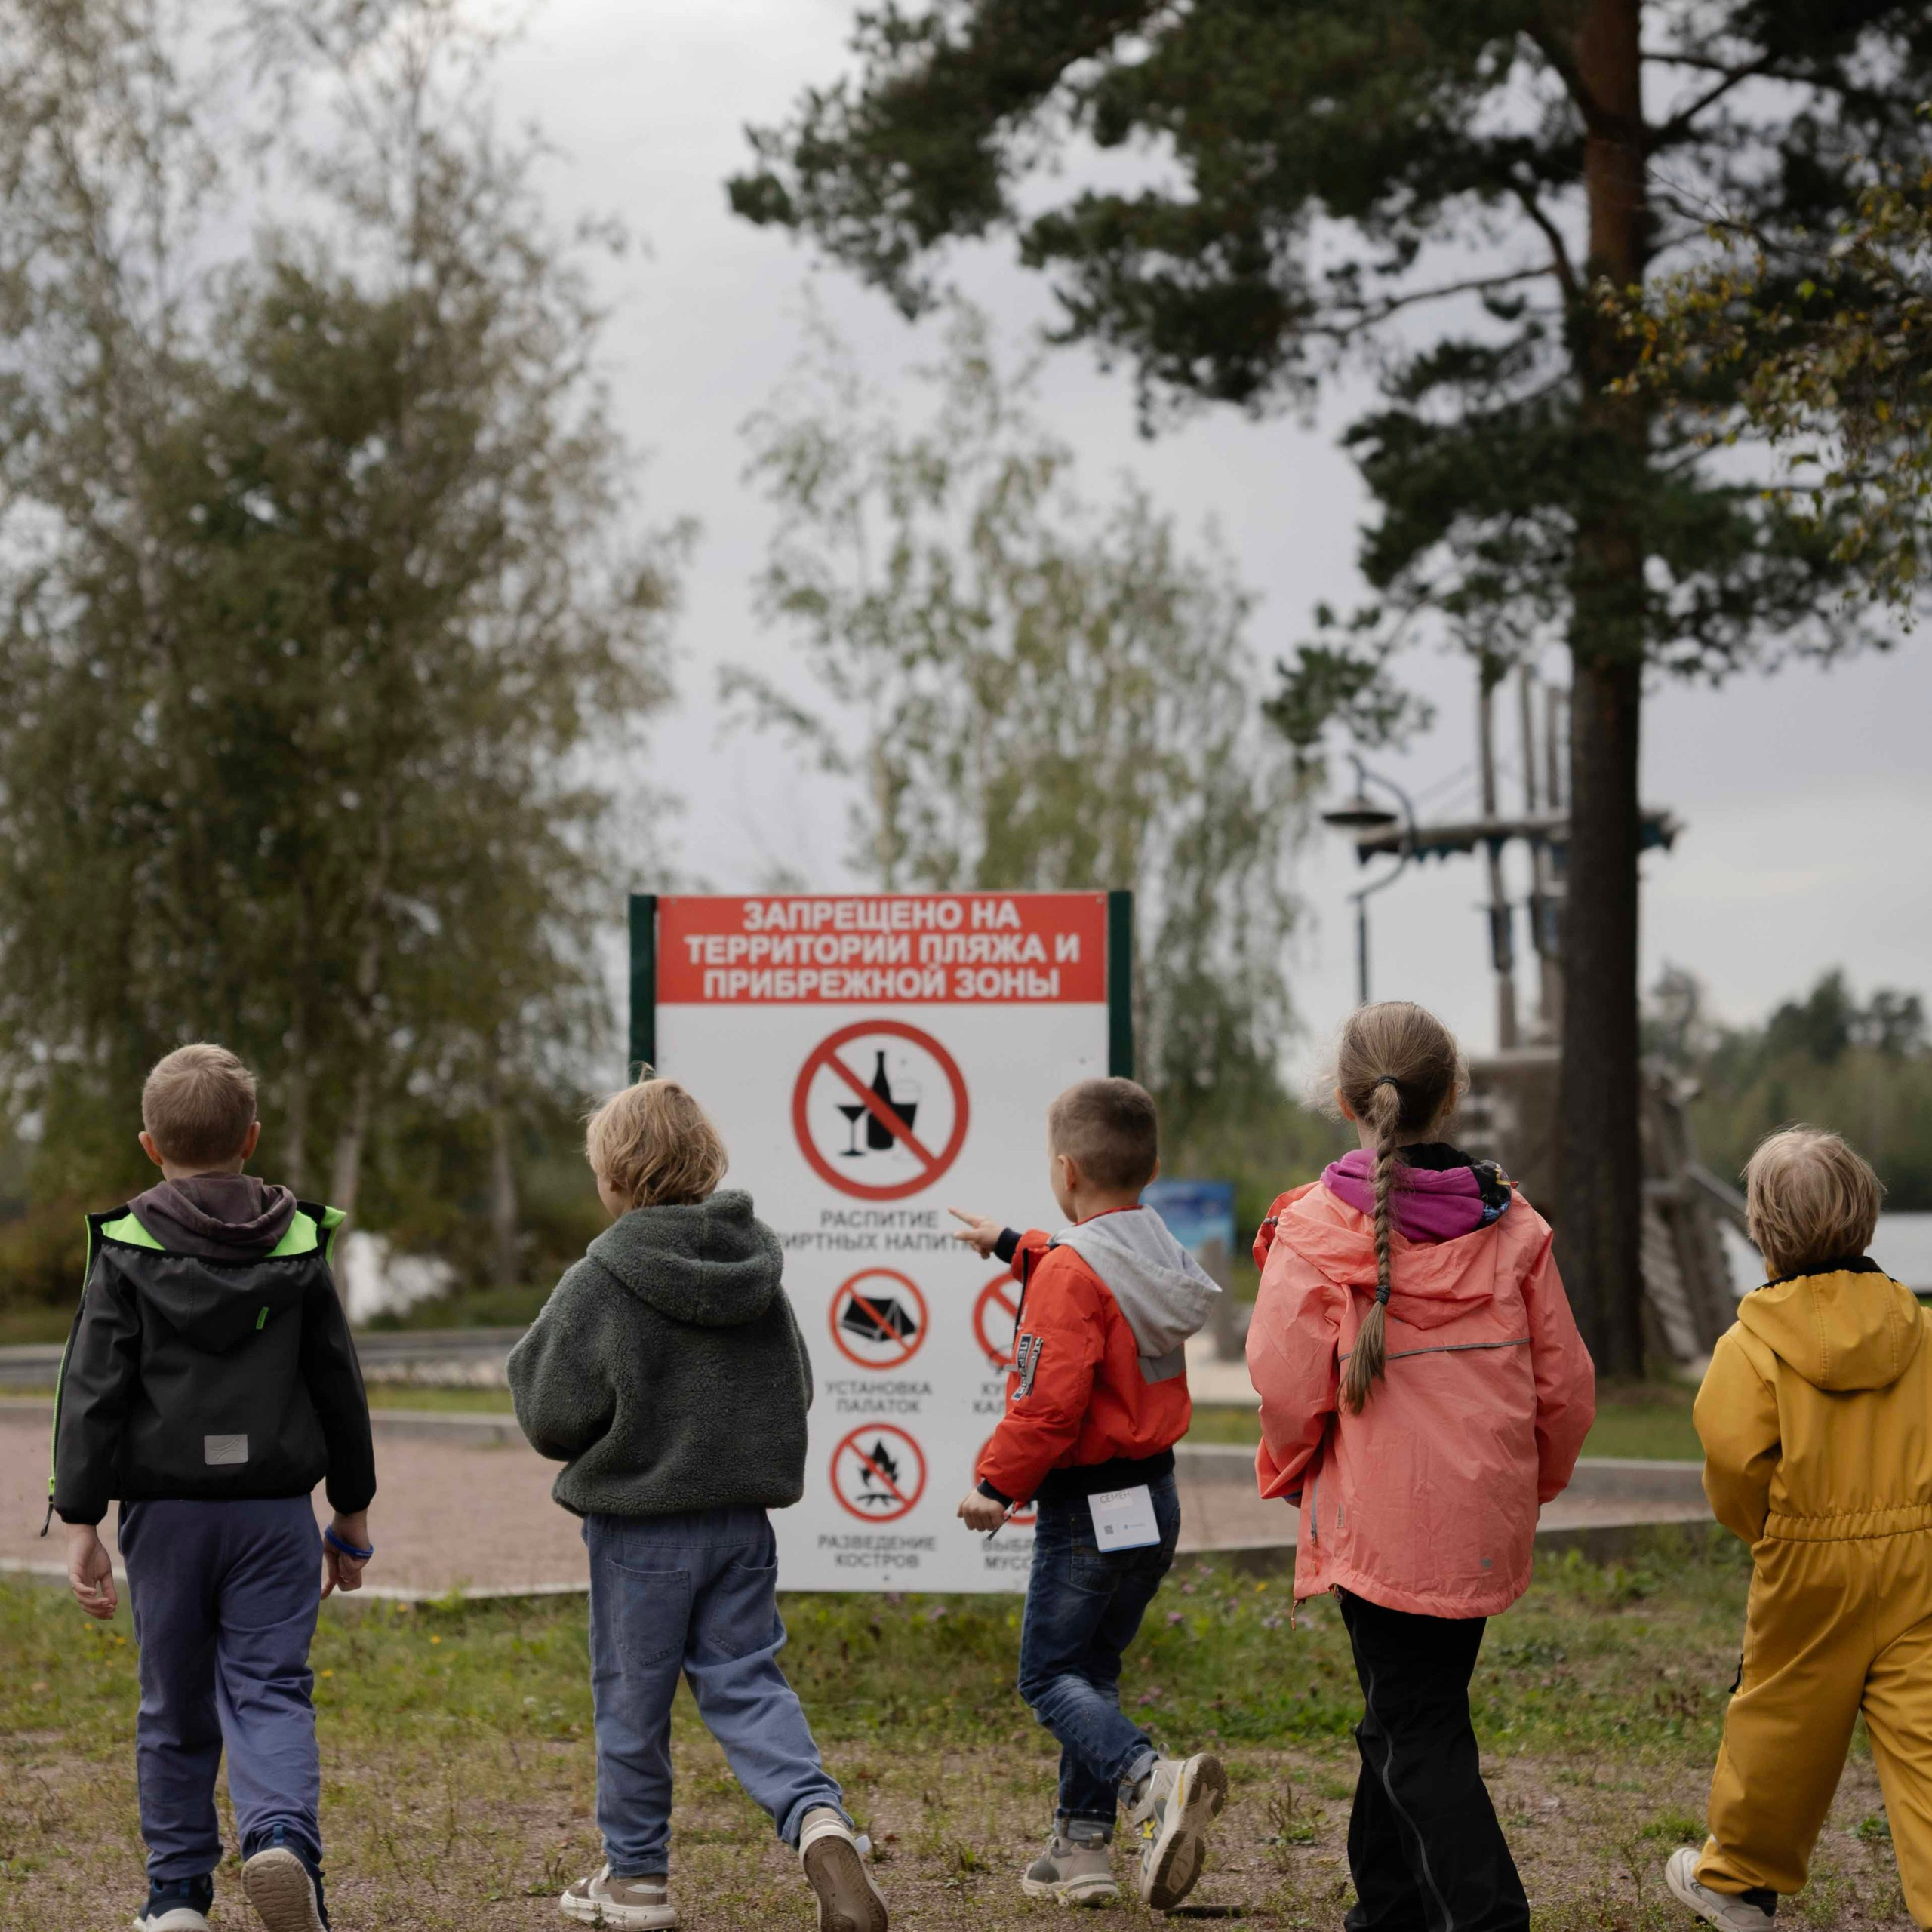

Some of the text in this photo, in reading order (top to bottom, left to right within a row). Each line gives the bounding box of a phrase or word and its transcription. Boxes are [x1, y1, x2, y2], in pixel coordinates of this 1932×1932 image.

[742, 899, 1022, 934] ЗАПРЕЩЕНО НА
[683, 933, 1081, 965] ТЕРРИТОРИИ ПЛЯЖА И
[703, 961, 1060, 999] ПРИБРЕЖНОЙ ЗОНЫ
[820, 1210, 939, 1228] РАСПИТИЕ
[824, 1380, 933, 1396] УСТАНОВКА
[836, 1398, 921, 1414] ПАЛАТОК
[817, 1534, 937, 1551] РАЗВЕДЕНИЕ
[834, 1552, 921, 1570] КОСТРОВ
